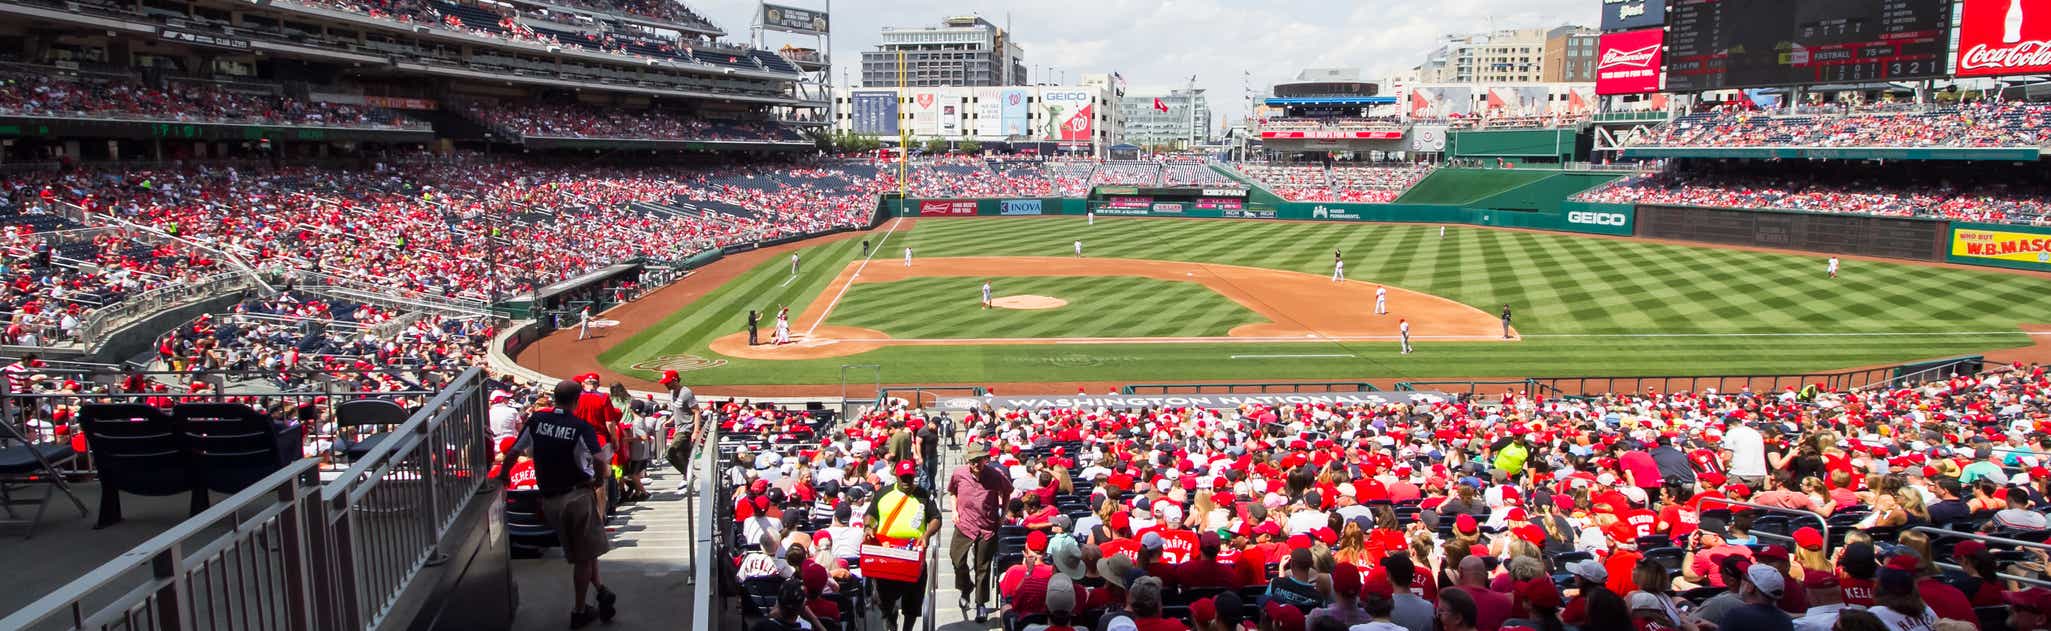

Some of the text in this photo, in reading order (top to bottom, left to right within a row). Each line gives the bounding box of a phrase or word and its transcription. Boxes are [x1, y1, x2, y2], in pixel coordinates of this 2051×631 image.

[1814, 51, 1850, 60] FASTBALL
[1892, 61, 1936, 74] 3 2 1
[1046, 92, 1087, 101] GEICO
[1011, 203, 1040, 211] INOVA
[1567, 211, 1626, 226] GEICO
[1006, 394, 1387, 408] WASHINGTON NATIONALS
[536, 422, 577, 441] ASK ME!
[1163, 538, 1193, 551] HARPER
[1844, 587, 1873, 600] KELL
